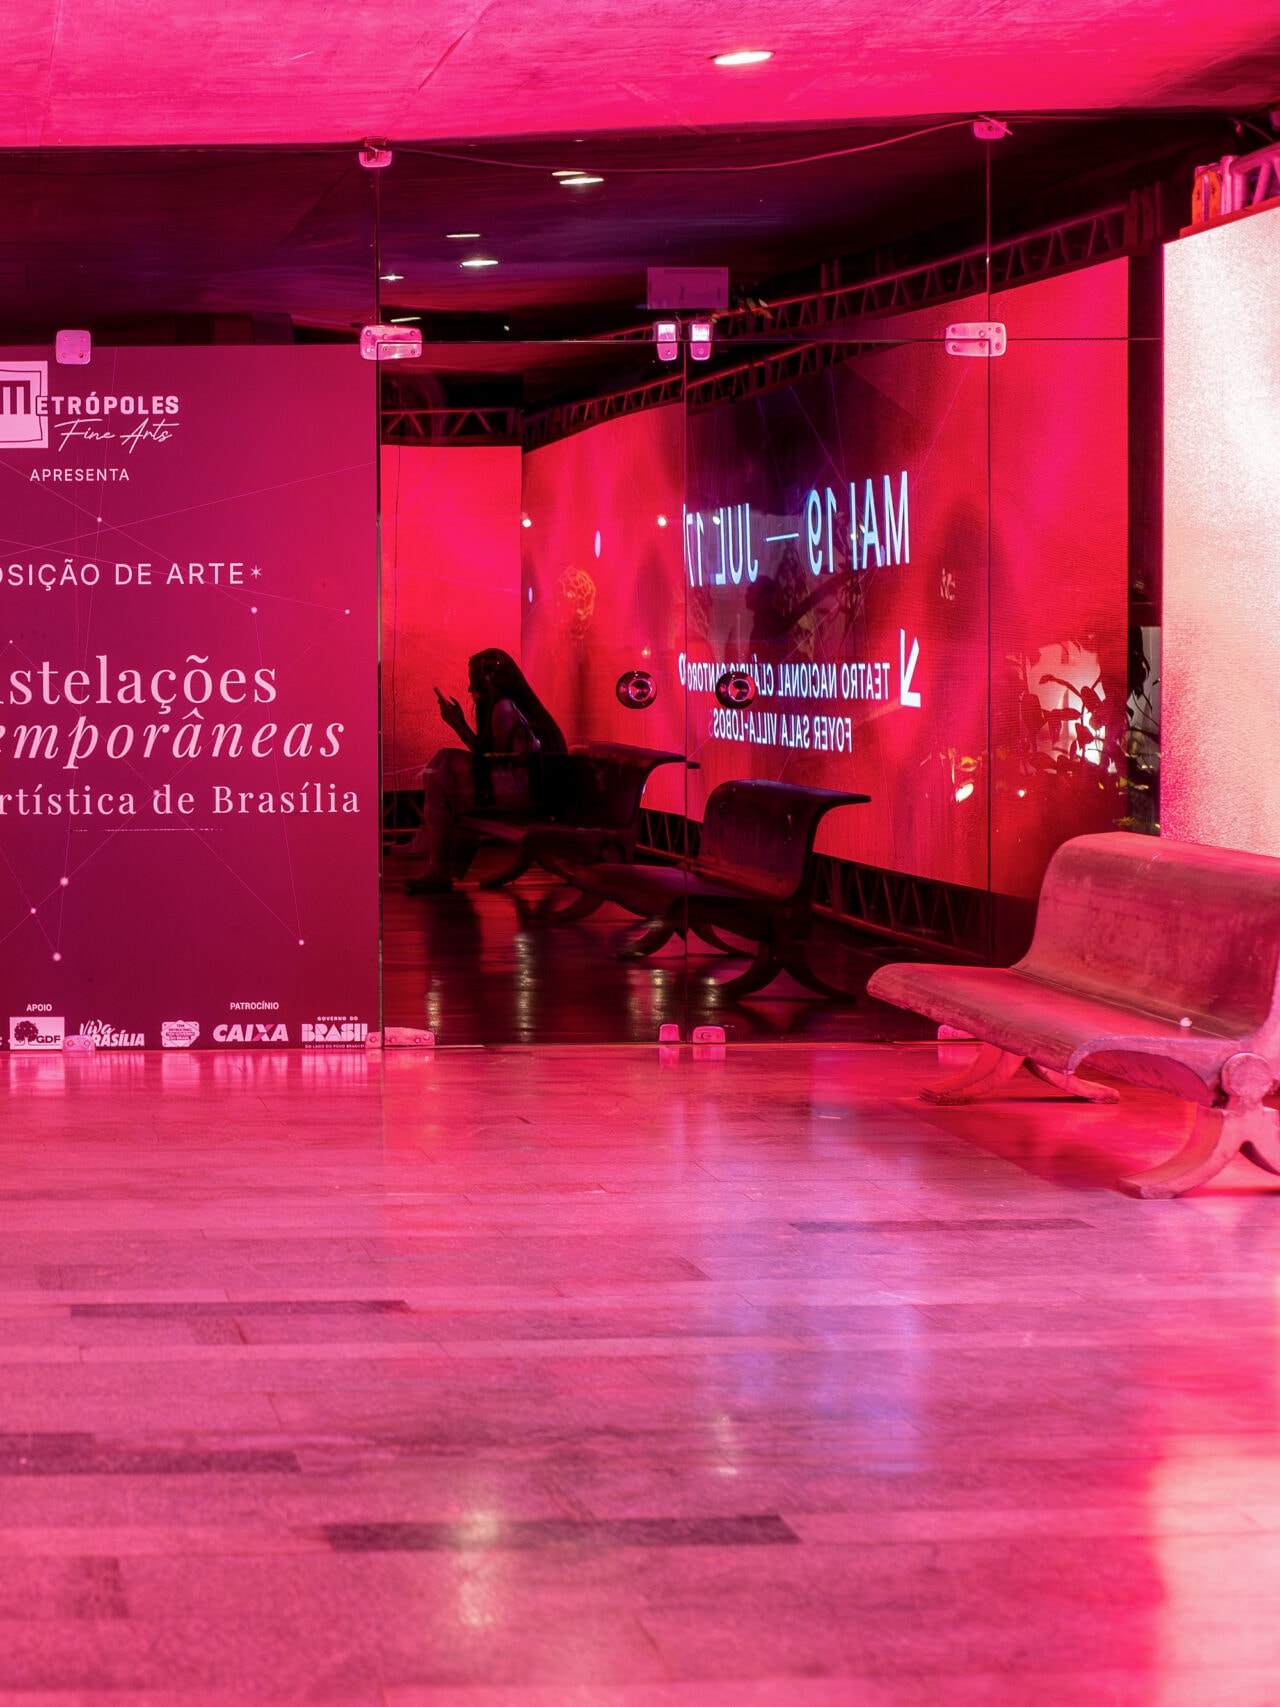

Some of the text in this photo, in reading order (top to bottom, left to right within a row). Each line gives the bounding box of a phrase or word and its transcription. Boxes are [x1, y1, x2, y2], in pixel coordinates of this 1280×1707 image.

[54, 418, 180, 454] Fine Arts
[29, 467, 130, 482] APRESENTA
[115, 562, 153, 586] DE
[165, 561, 246, 586] ARTE
[152, 783, 196, 815] de
[211, 781, 361, 815] Brasília
[26, 1003, 53, 1012] APOIO
[229, 1000, 280, 1011] PATROCÍNIO
[35, 1034, 62, 1044] GDF
[89, 1029, 145, 1047] RASÍLIA
[213, 1024, 289, 1042] CAIXA
